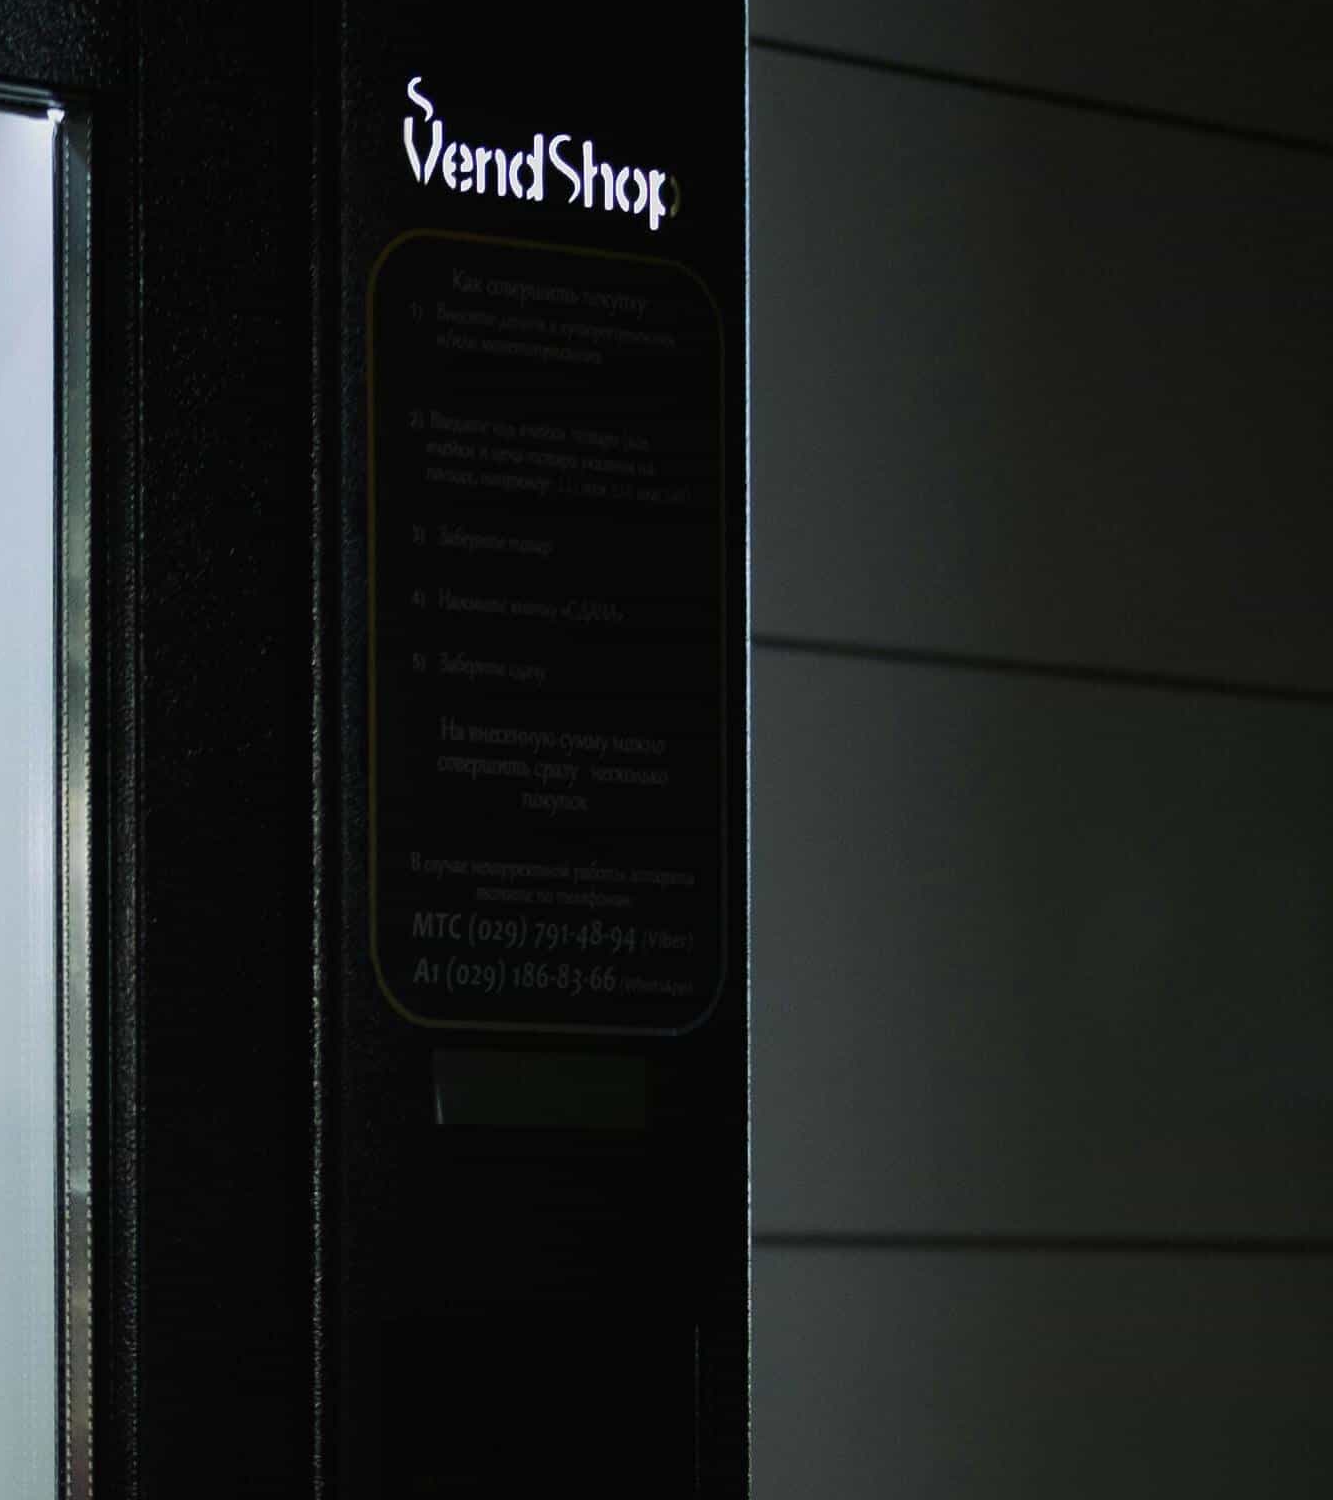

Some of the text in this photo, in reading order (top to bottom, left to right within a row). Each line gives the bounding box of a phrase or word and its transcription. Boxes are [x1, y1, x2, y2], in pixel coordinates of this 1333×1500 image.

[402, 112, 682, 233] VendShop
[468, 911, 527, 948] (029)
[445, 956, 506, 995] (029)
